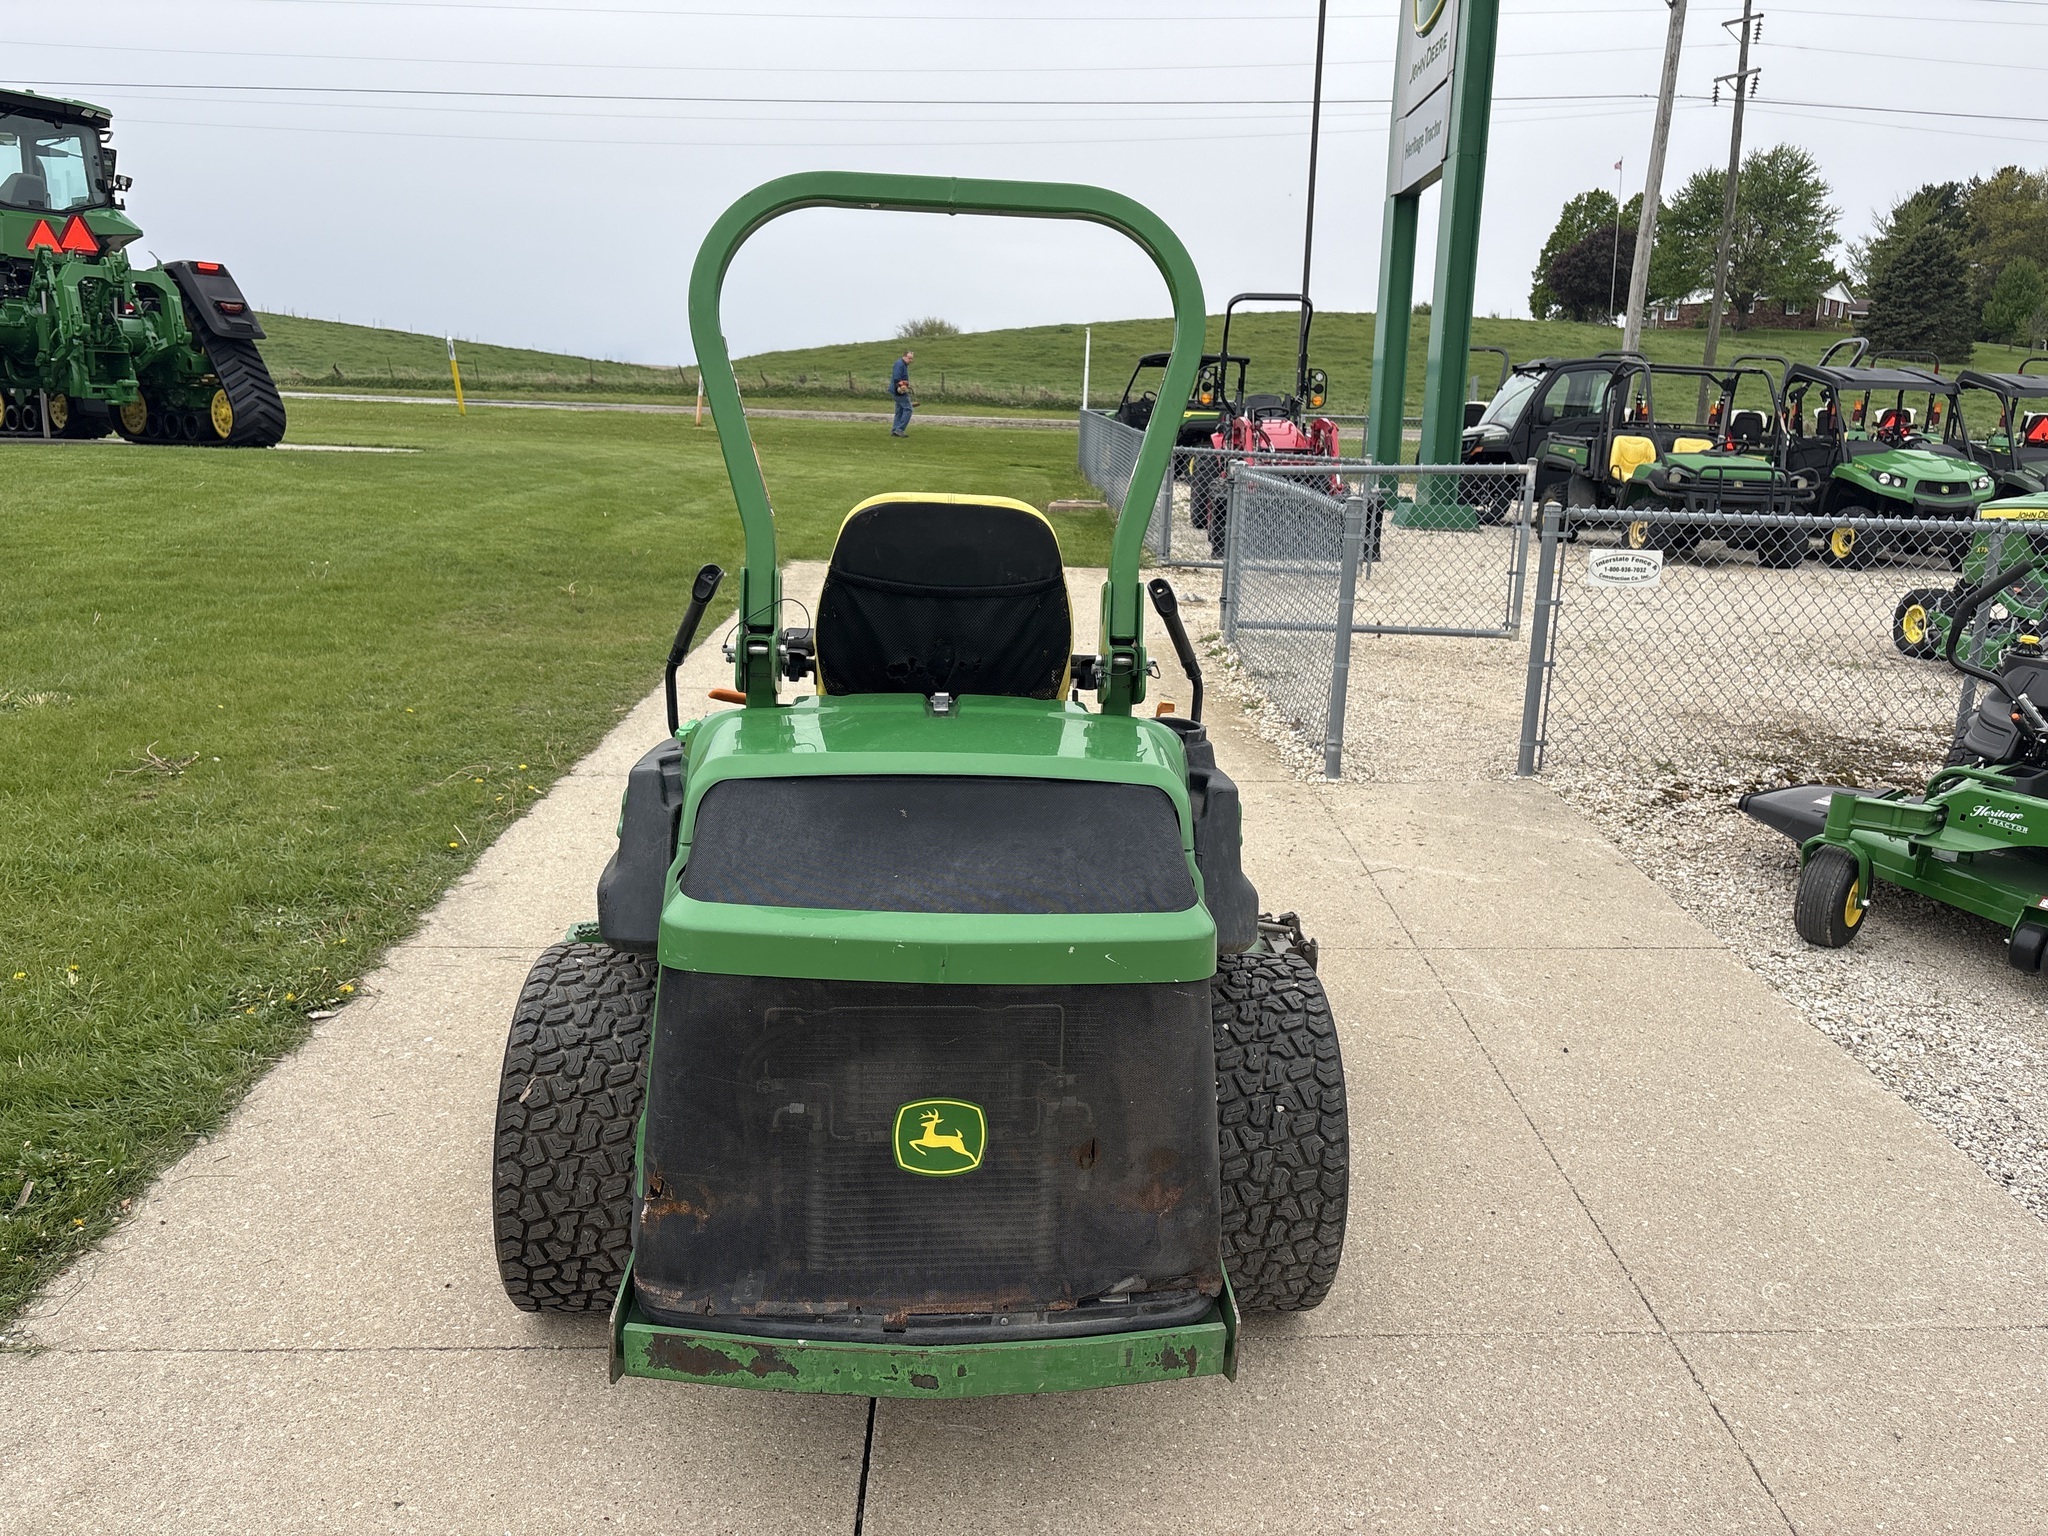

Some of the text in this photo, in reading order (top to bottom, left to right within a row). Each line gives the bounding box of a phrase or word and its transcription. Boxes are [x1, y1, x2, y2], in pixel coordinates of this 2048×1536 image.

[1408, 31, 1448, 85] JOHN DEERE
[1405, 119, 1442, 160] Heritage Tractor
[2015, 511, 2038, 519] JOHN
[1595, 556, 1630, 568] Interstate
[1631, 556, 1652, 567] Fence
[1598, 572, 1630, 581] Construction
[1970, 805, 2024, 821] Heritage
[1987, 817, 2029, 834] TRACTOR
